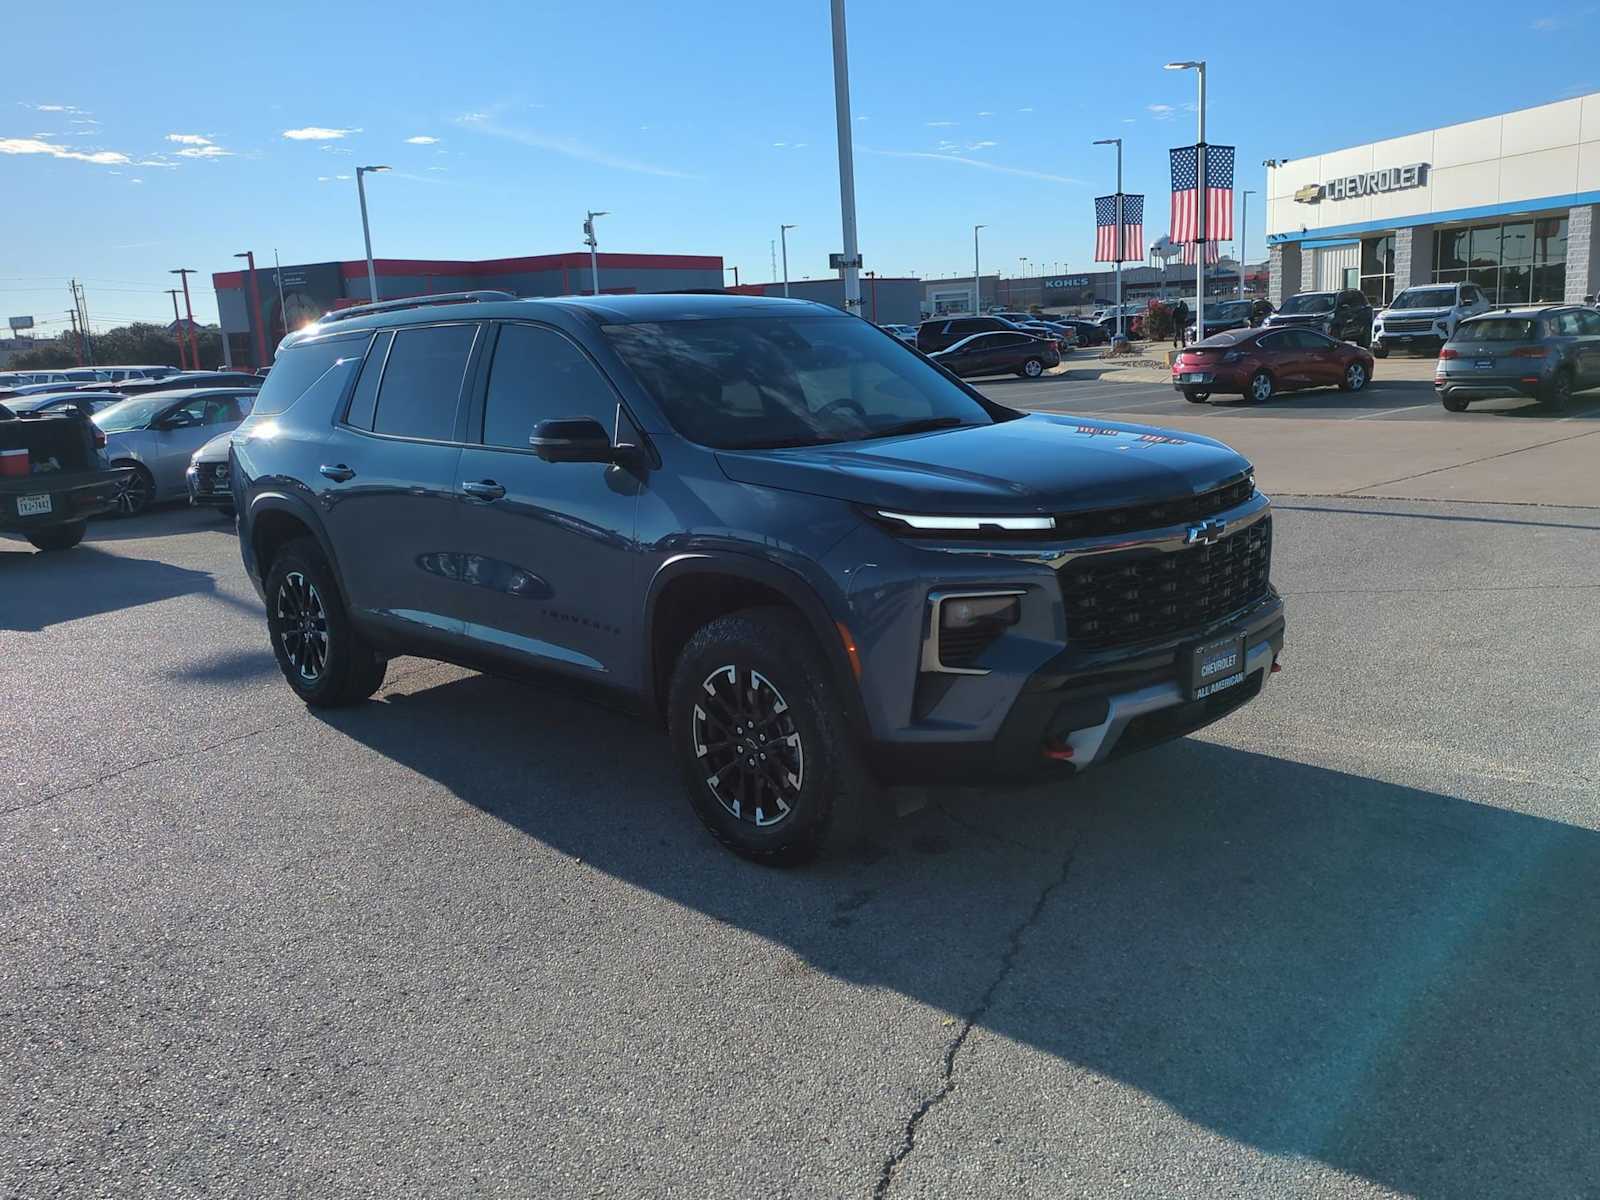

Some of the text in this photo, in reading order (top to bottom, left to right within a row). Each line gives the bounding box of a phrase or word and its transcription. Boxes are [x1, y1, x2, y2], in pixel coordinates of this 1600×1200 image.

[1325, 162, 1427, 200] CHEVROLET
[1201, 654, 1237, 677] CHEVROLET
[1197, 672, 1244, 699] ALL AMERICAN
